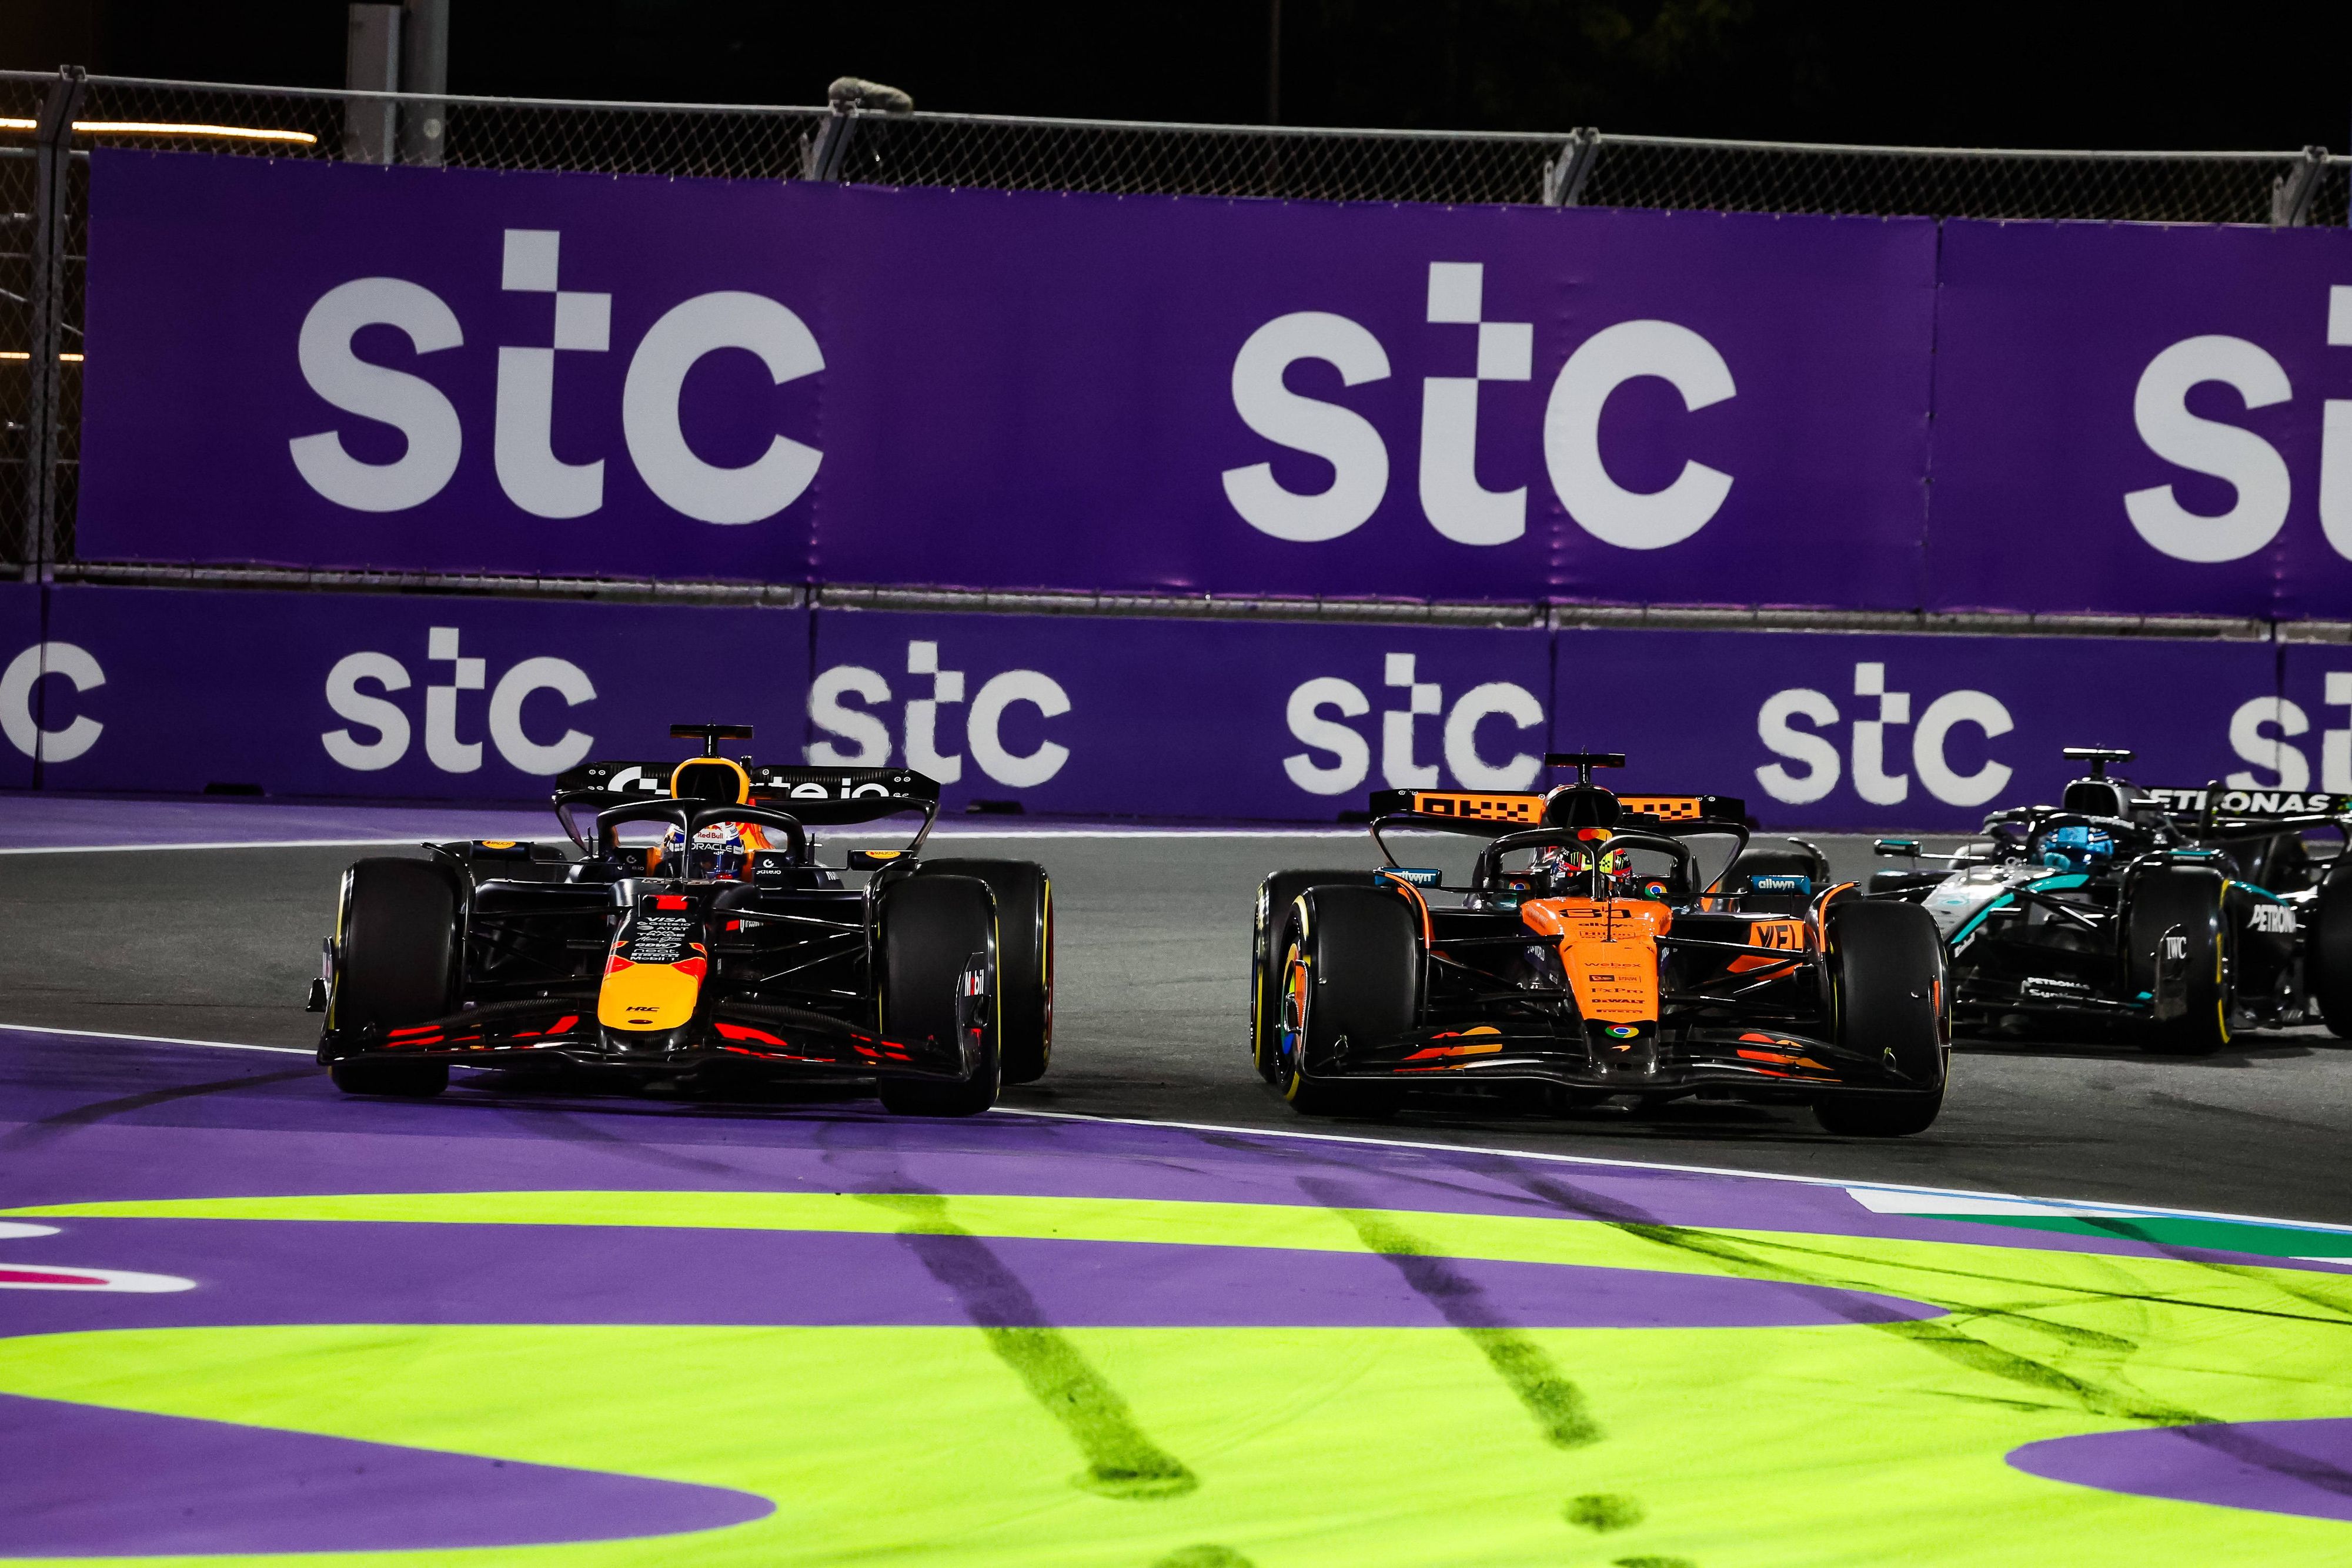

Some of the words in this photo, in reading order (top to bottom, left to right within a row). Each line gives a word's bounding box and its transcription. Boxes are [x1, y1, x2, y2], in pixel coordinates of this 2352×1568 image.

[290, 229, 825, 524] stc
[1223, 262, 1736, 550] stc
[322, 627, 597, 775] stc
[804, 640, 1071, 788] stc
[1284, 653, 1545, 795] stc
[1755, 663, 2014, 807] stc
[1758, 878, 1795, 891] allwyn
[2166, 937, 2187, 960] IWC
[964, 969, 984, 997] Mobil
